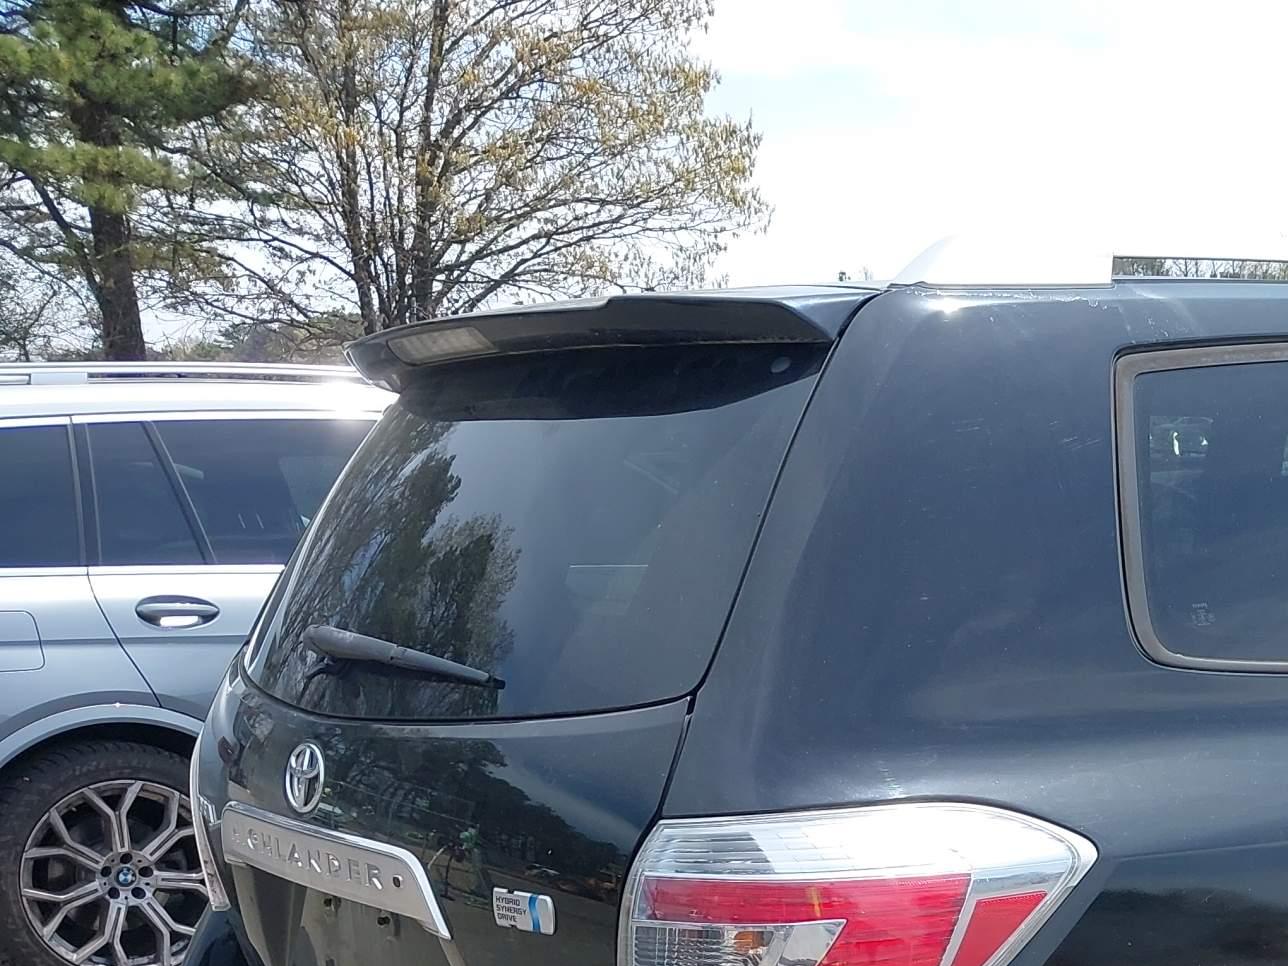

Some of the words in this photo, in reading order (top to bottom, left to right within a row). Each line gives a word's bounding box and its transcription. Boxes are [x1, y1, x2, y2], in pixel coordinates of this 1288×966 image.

[231, 826, 384, 890] HGHLANDER
[495, 895, 521, 906] HYBRID
[496, 904, 527, 916] SYNERGY
[497, 912, 518, 923] DRIVE
